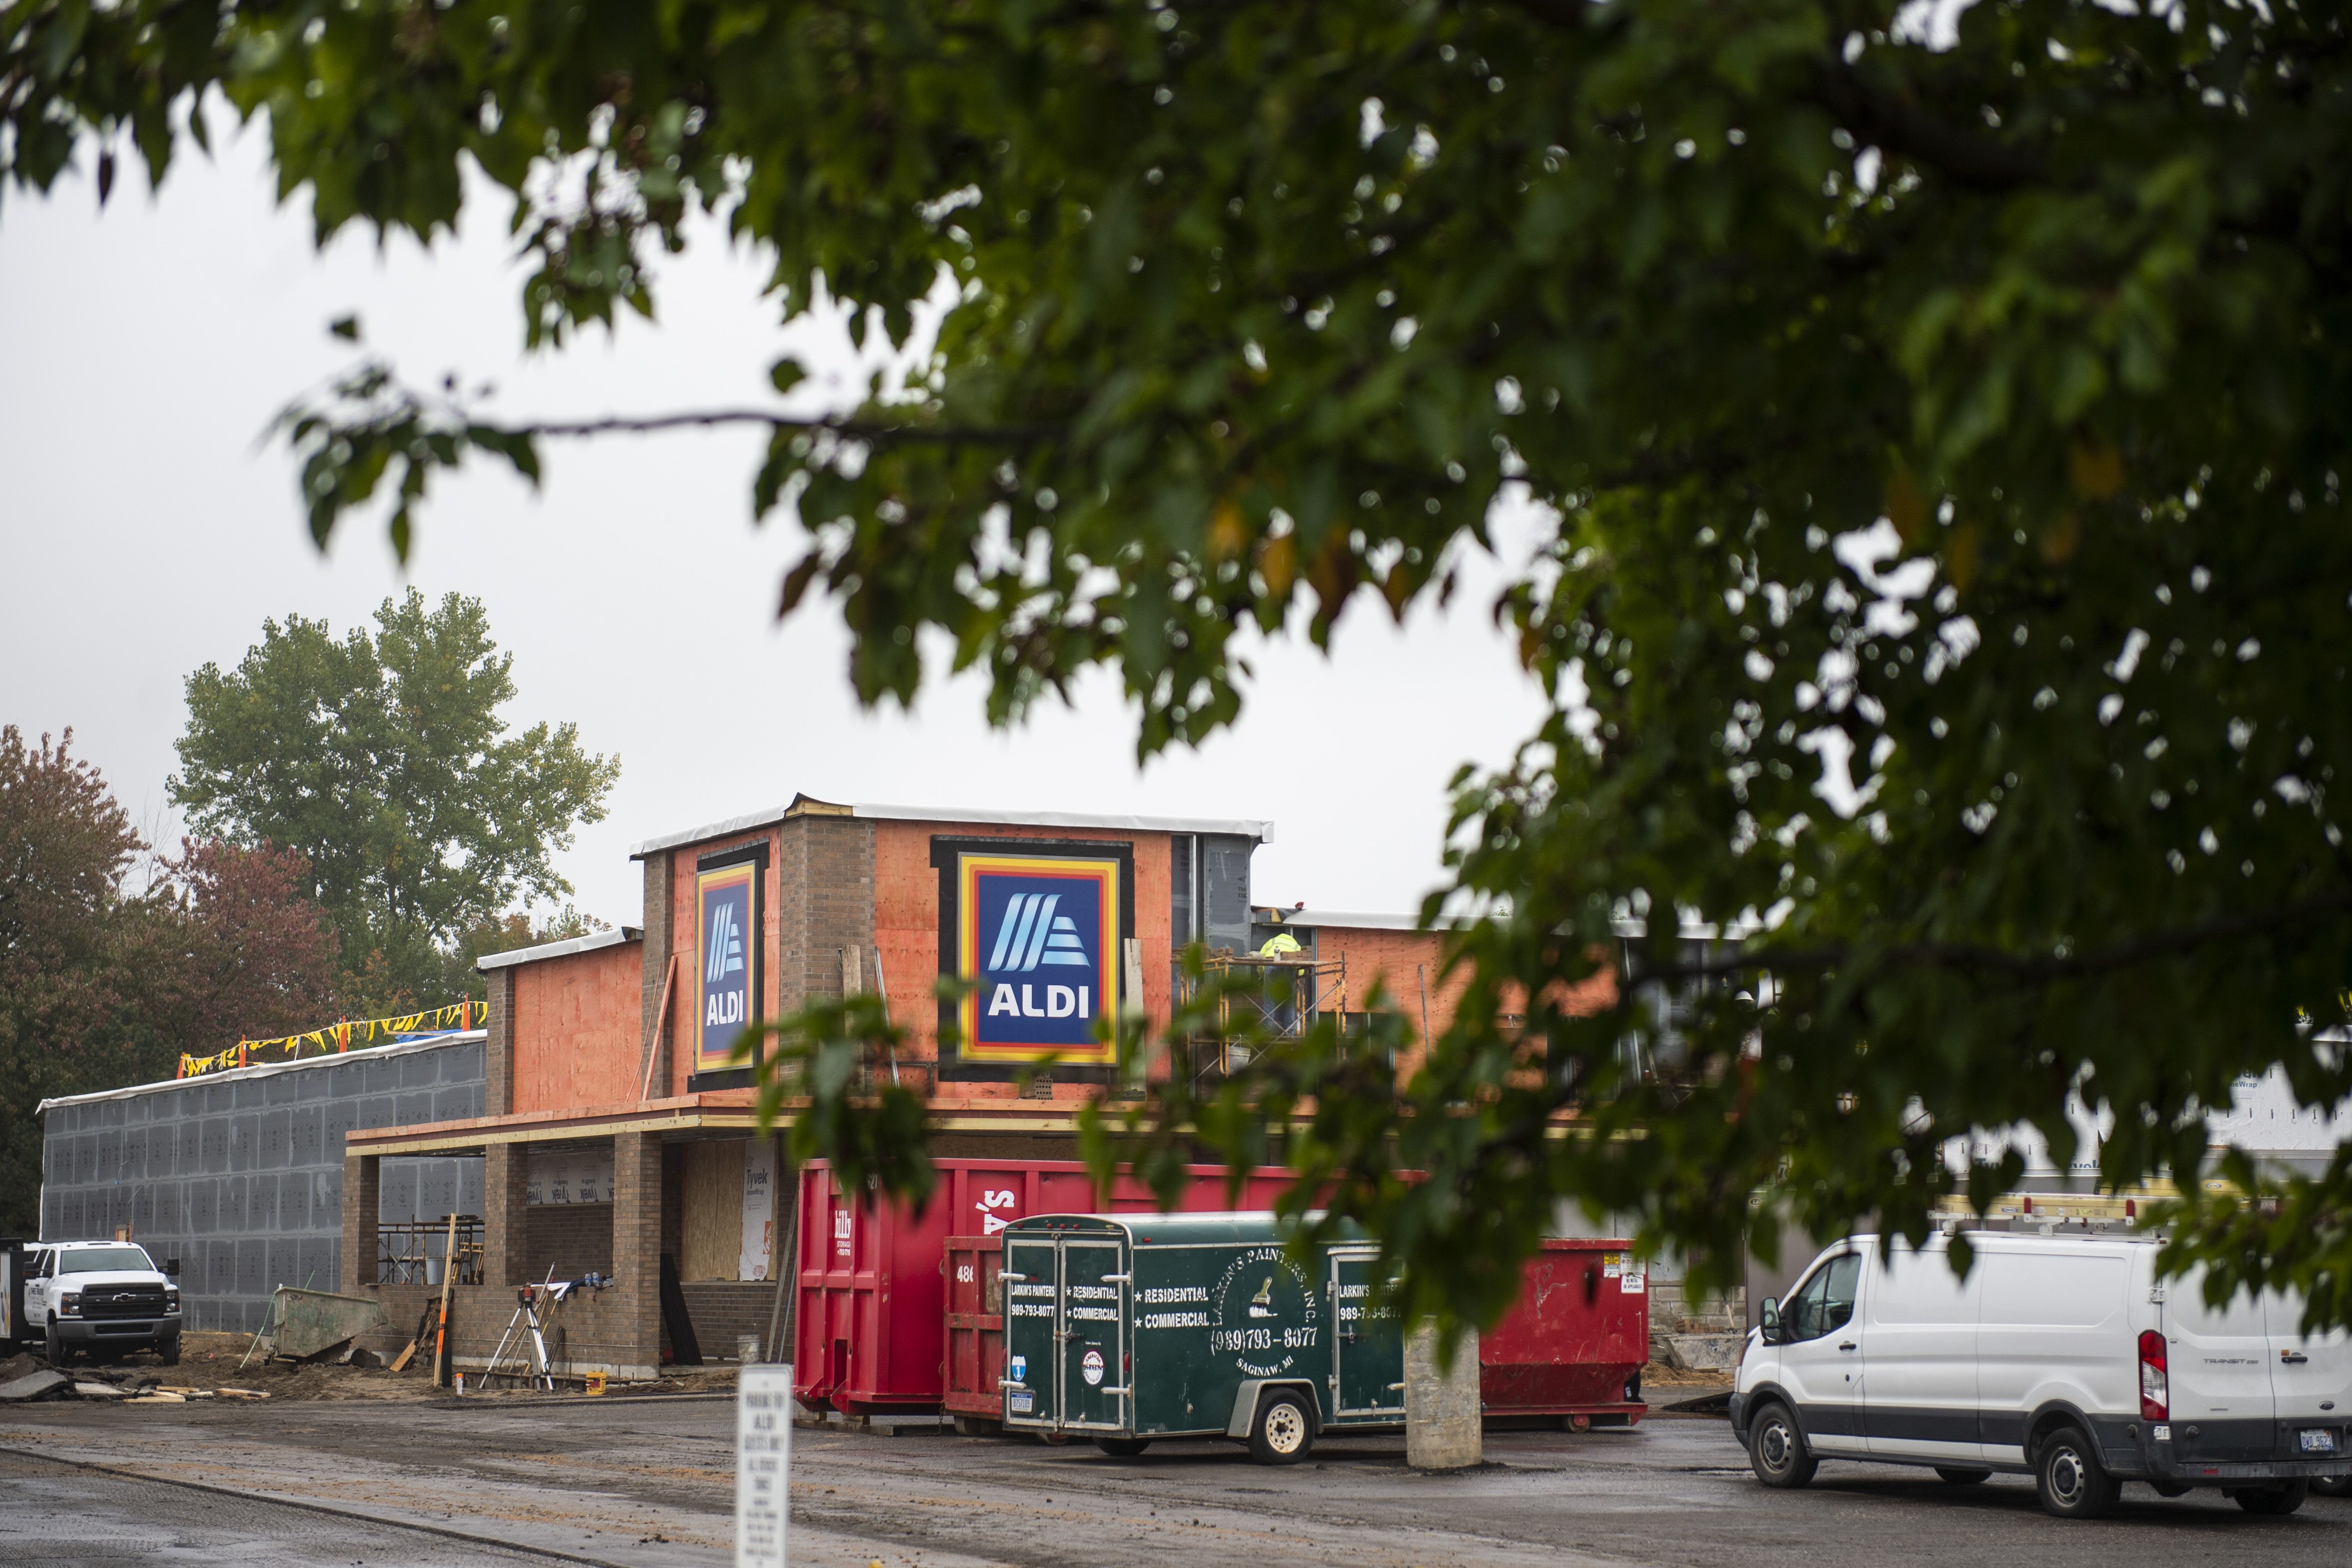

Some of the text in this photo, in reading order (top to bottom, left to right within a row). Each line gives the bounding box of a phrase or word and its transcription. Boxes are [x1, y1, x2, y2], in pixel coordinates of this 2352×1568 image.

[706, 989, 743, 1027] ALDI
[988, 983, 1089, 1018] ALDI
[747, 1168, 768, 1189] Tyvek
[552, 1185, 571, 1204] Tyvek
[580, 1185, 599, 1203] Tyvek
[834, 1210, 851, 1238] billy
[1011, 1284, 1055, 1297] LARKIN'S PAINTERS
[1074, 1286, 1118, 1300] RESIDENTIAL
[1145, 1287, 1209, 1303] RESIDENTIAL
[1339, 1284, 1370, 1298] LARKIN'S
[1011, 1304, 1054, 1317] 989-793-8077
[1074, 1307, 1119, 1321] COMMERCIAL
[1304, 1290, 1316, 1323] INC.
[1145, 1312, 1209, 1328] COMMERCIAL
[1016, 1366, 1021, 1378] 1
[1236, 1355, 1294, 1377] SAGINAW, MI
